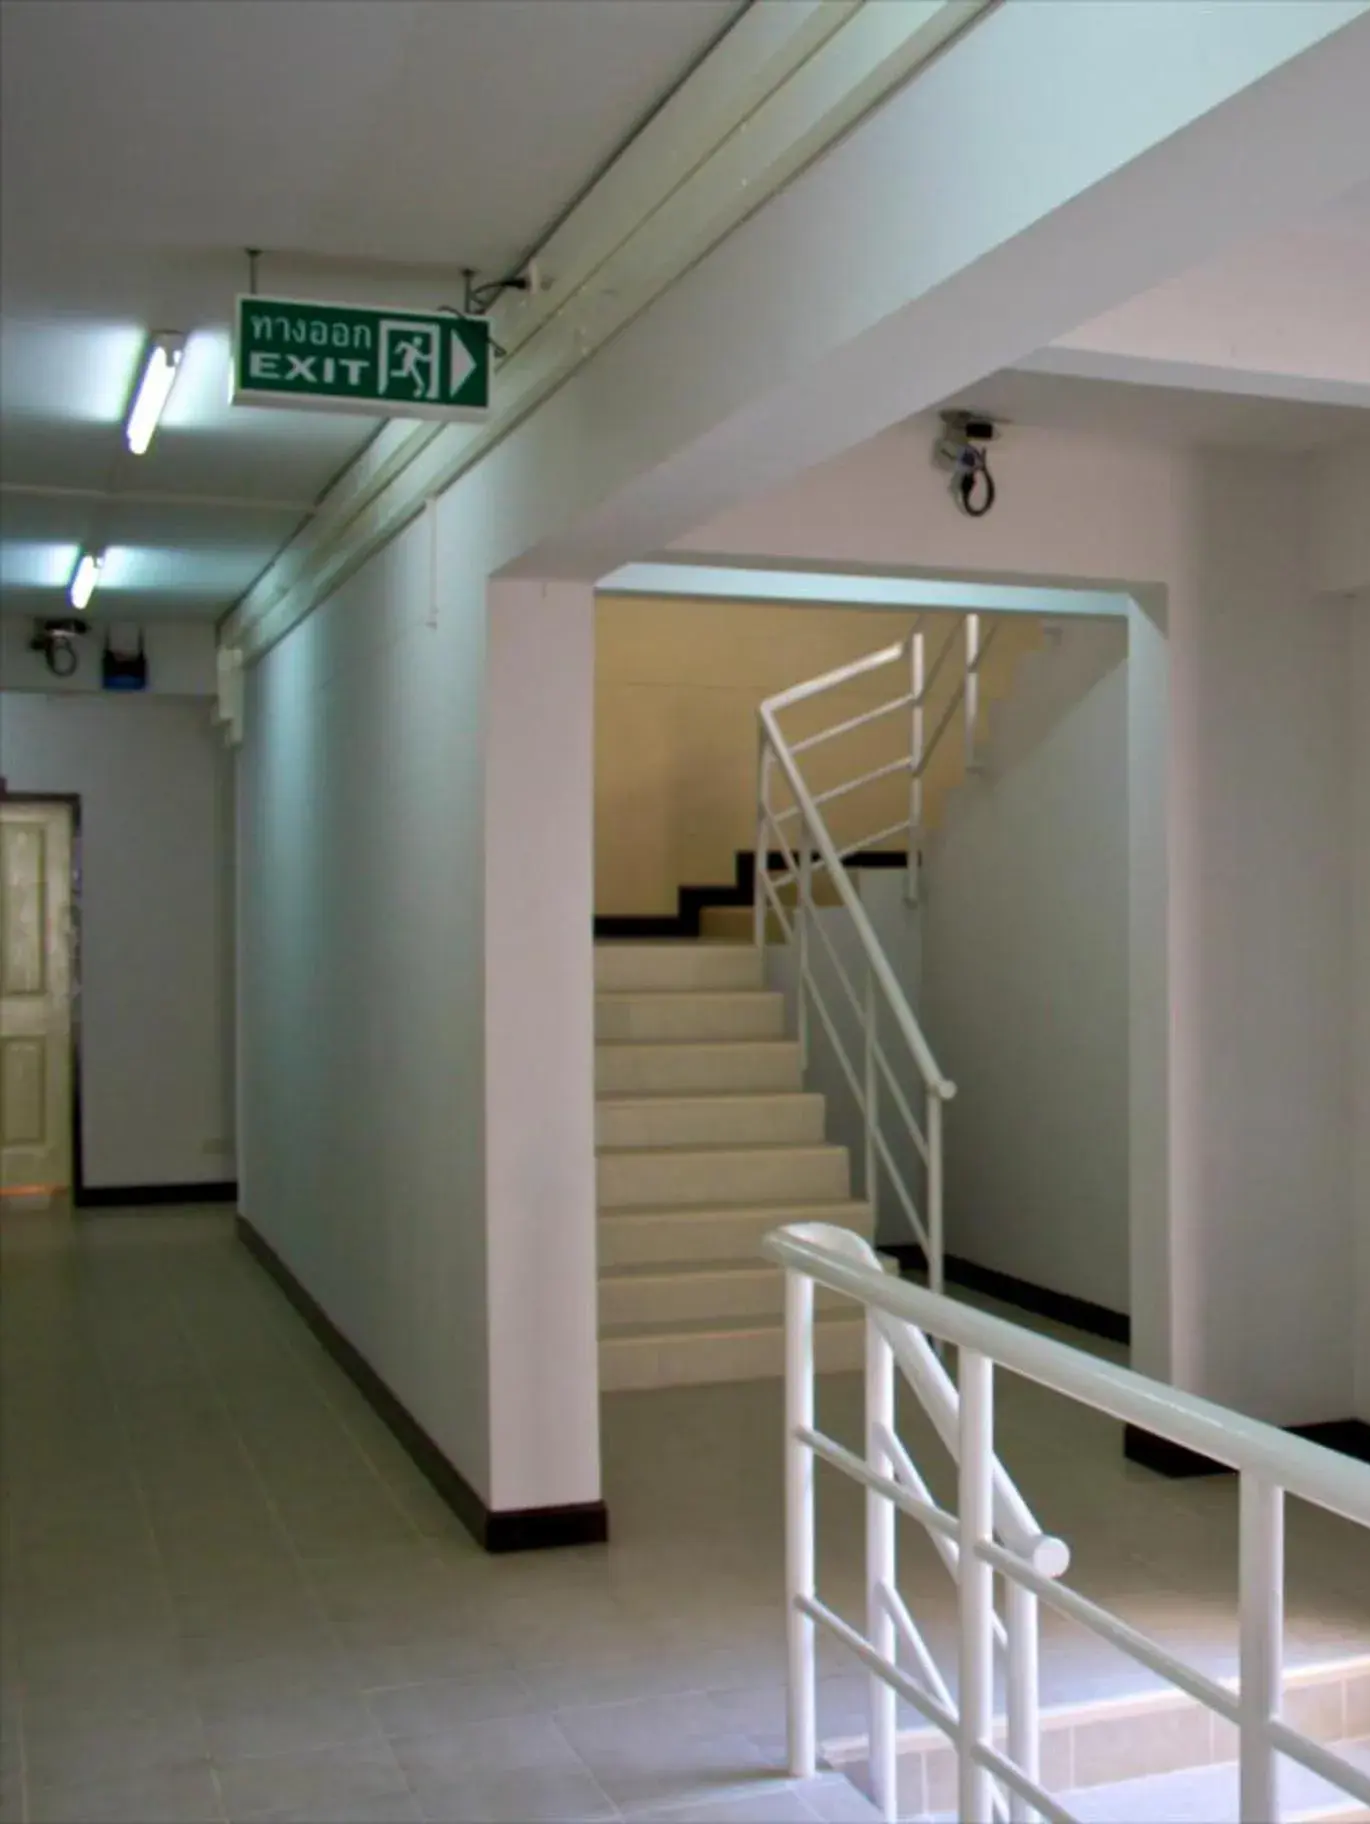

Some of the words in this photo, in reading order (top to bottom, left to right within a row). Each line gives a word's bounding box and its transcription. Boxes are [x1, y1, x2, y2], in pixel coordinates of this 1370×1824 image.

[251, 315, 371, 348] ทางออก
[250, 352, 370, 386] EXIT
